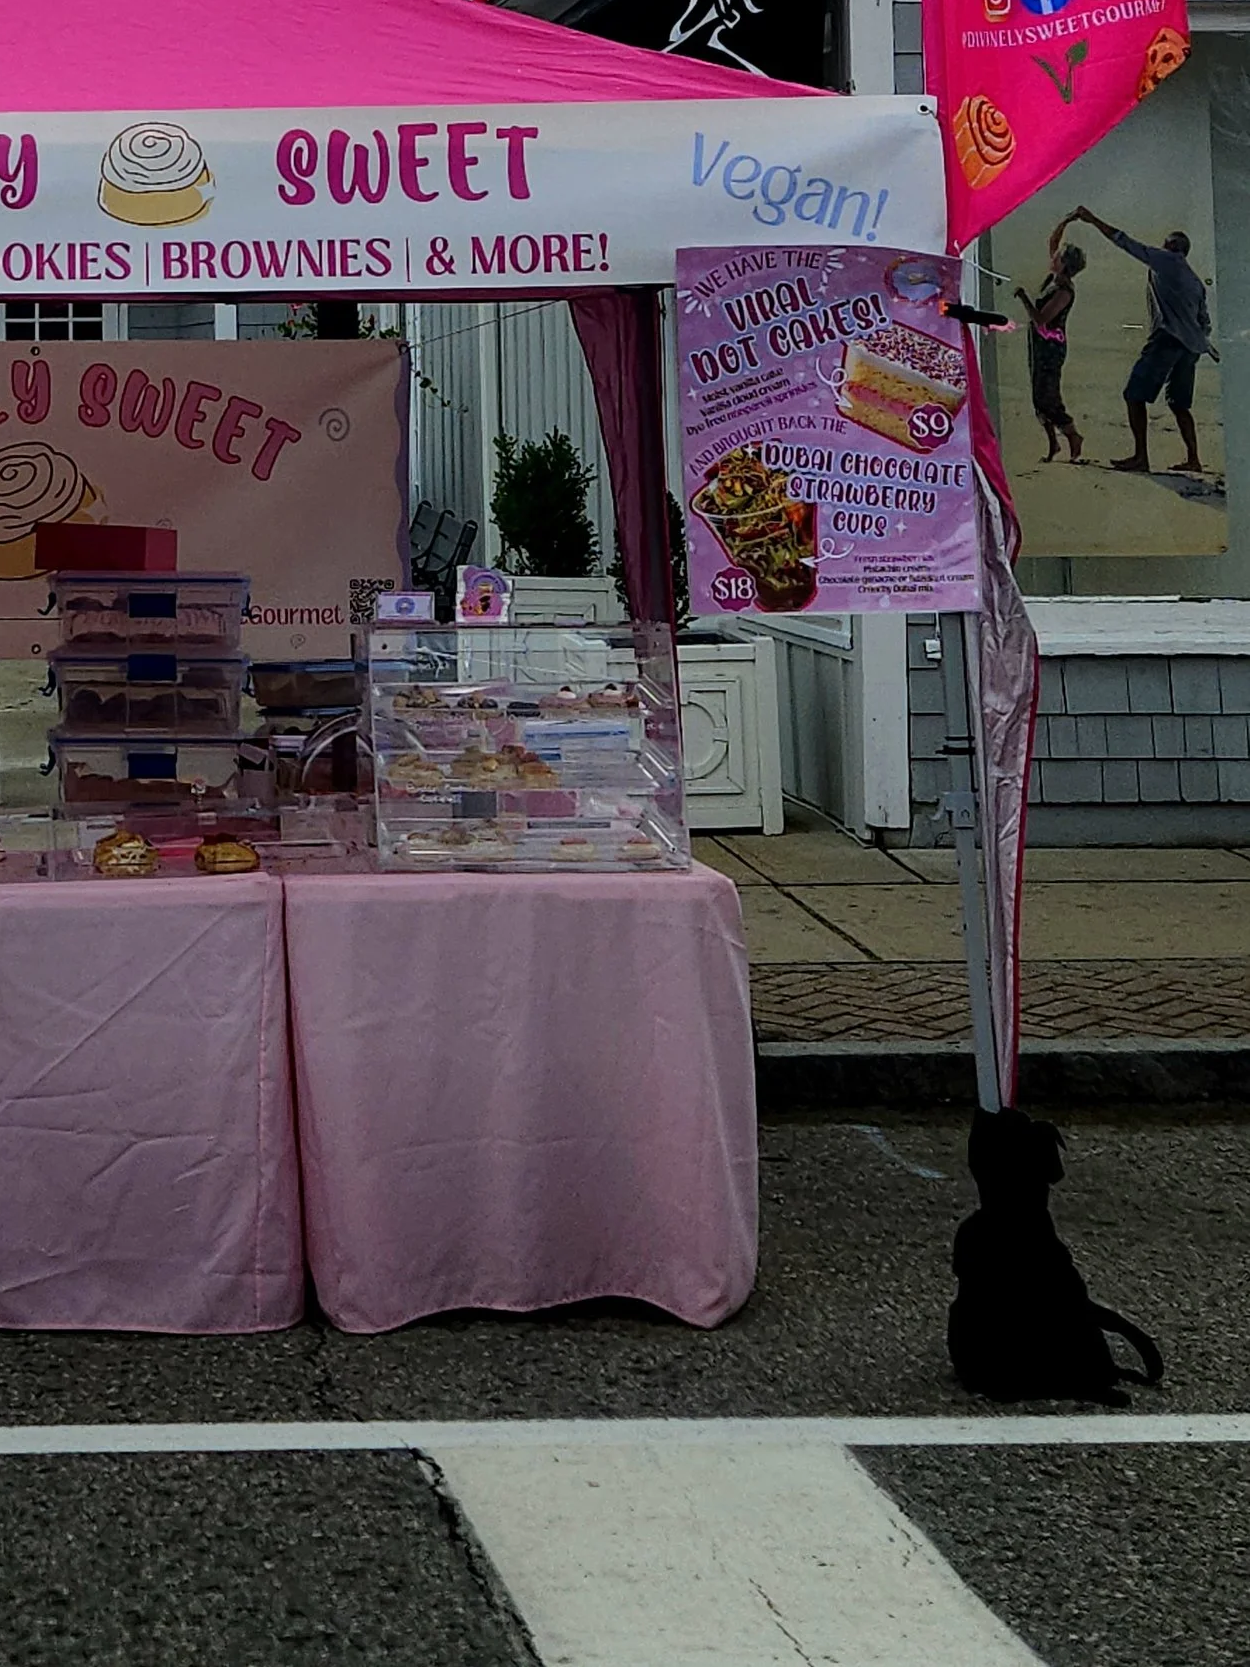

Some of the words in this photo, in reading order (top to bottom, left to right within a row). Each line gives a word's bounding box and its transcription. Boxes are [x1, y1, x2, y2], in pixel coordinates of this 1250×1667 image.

[276, 122, 539, 206] SWEET
[691, 131, 889, 242] Vegan!
[162, 238, 392, 279] BROWNIES
[425, 235, 456, 275] &
[470, 232, 610, 274] MORE!
[694, 269, 727, 298] WE
[724, 251, 777, 280] HAVE
[782, 250, 822, 270] THE
[724, 277, 817, 332] VIRAL
[690, 335, 760, 384] DOT
[768, 294, 888, 357] CAKES!
[78, 363, 301, 481] SWEET
[689, 449, 715, 476] AND
[712, 418, 775, 456] BROUGHT
[778, 415, 817, 430] BACK
[820, 416, 848, 435] THE
[911, 411, 950, 438] $9
[764, 443, 833, 473] DUBAI
[840, 452, 968, 487] CHOCOLATE
[790, 476, 936, 514] STRAWBERRY
[833, 511, 887, 538] CUPS
[713, 577, 753, 601] $18
